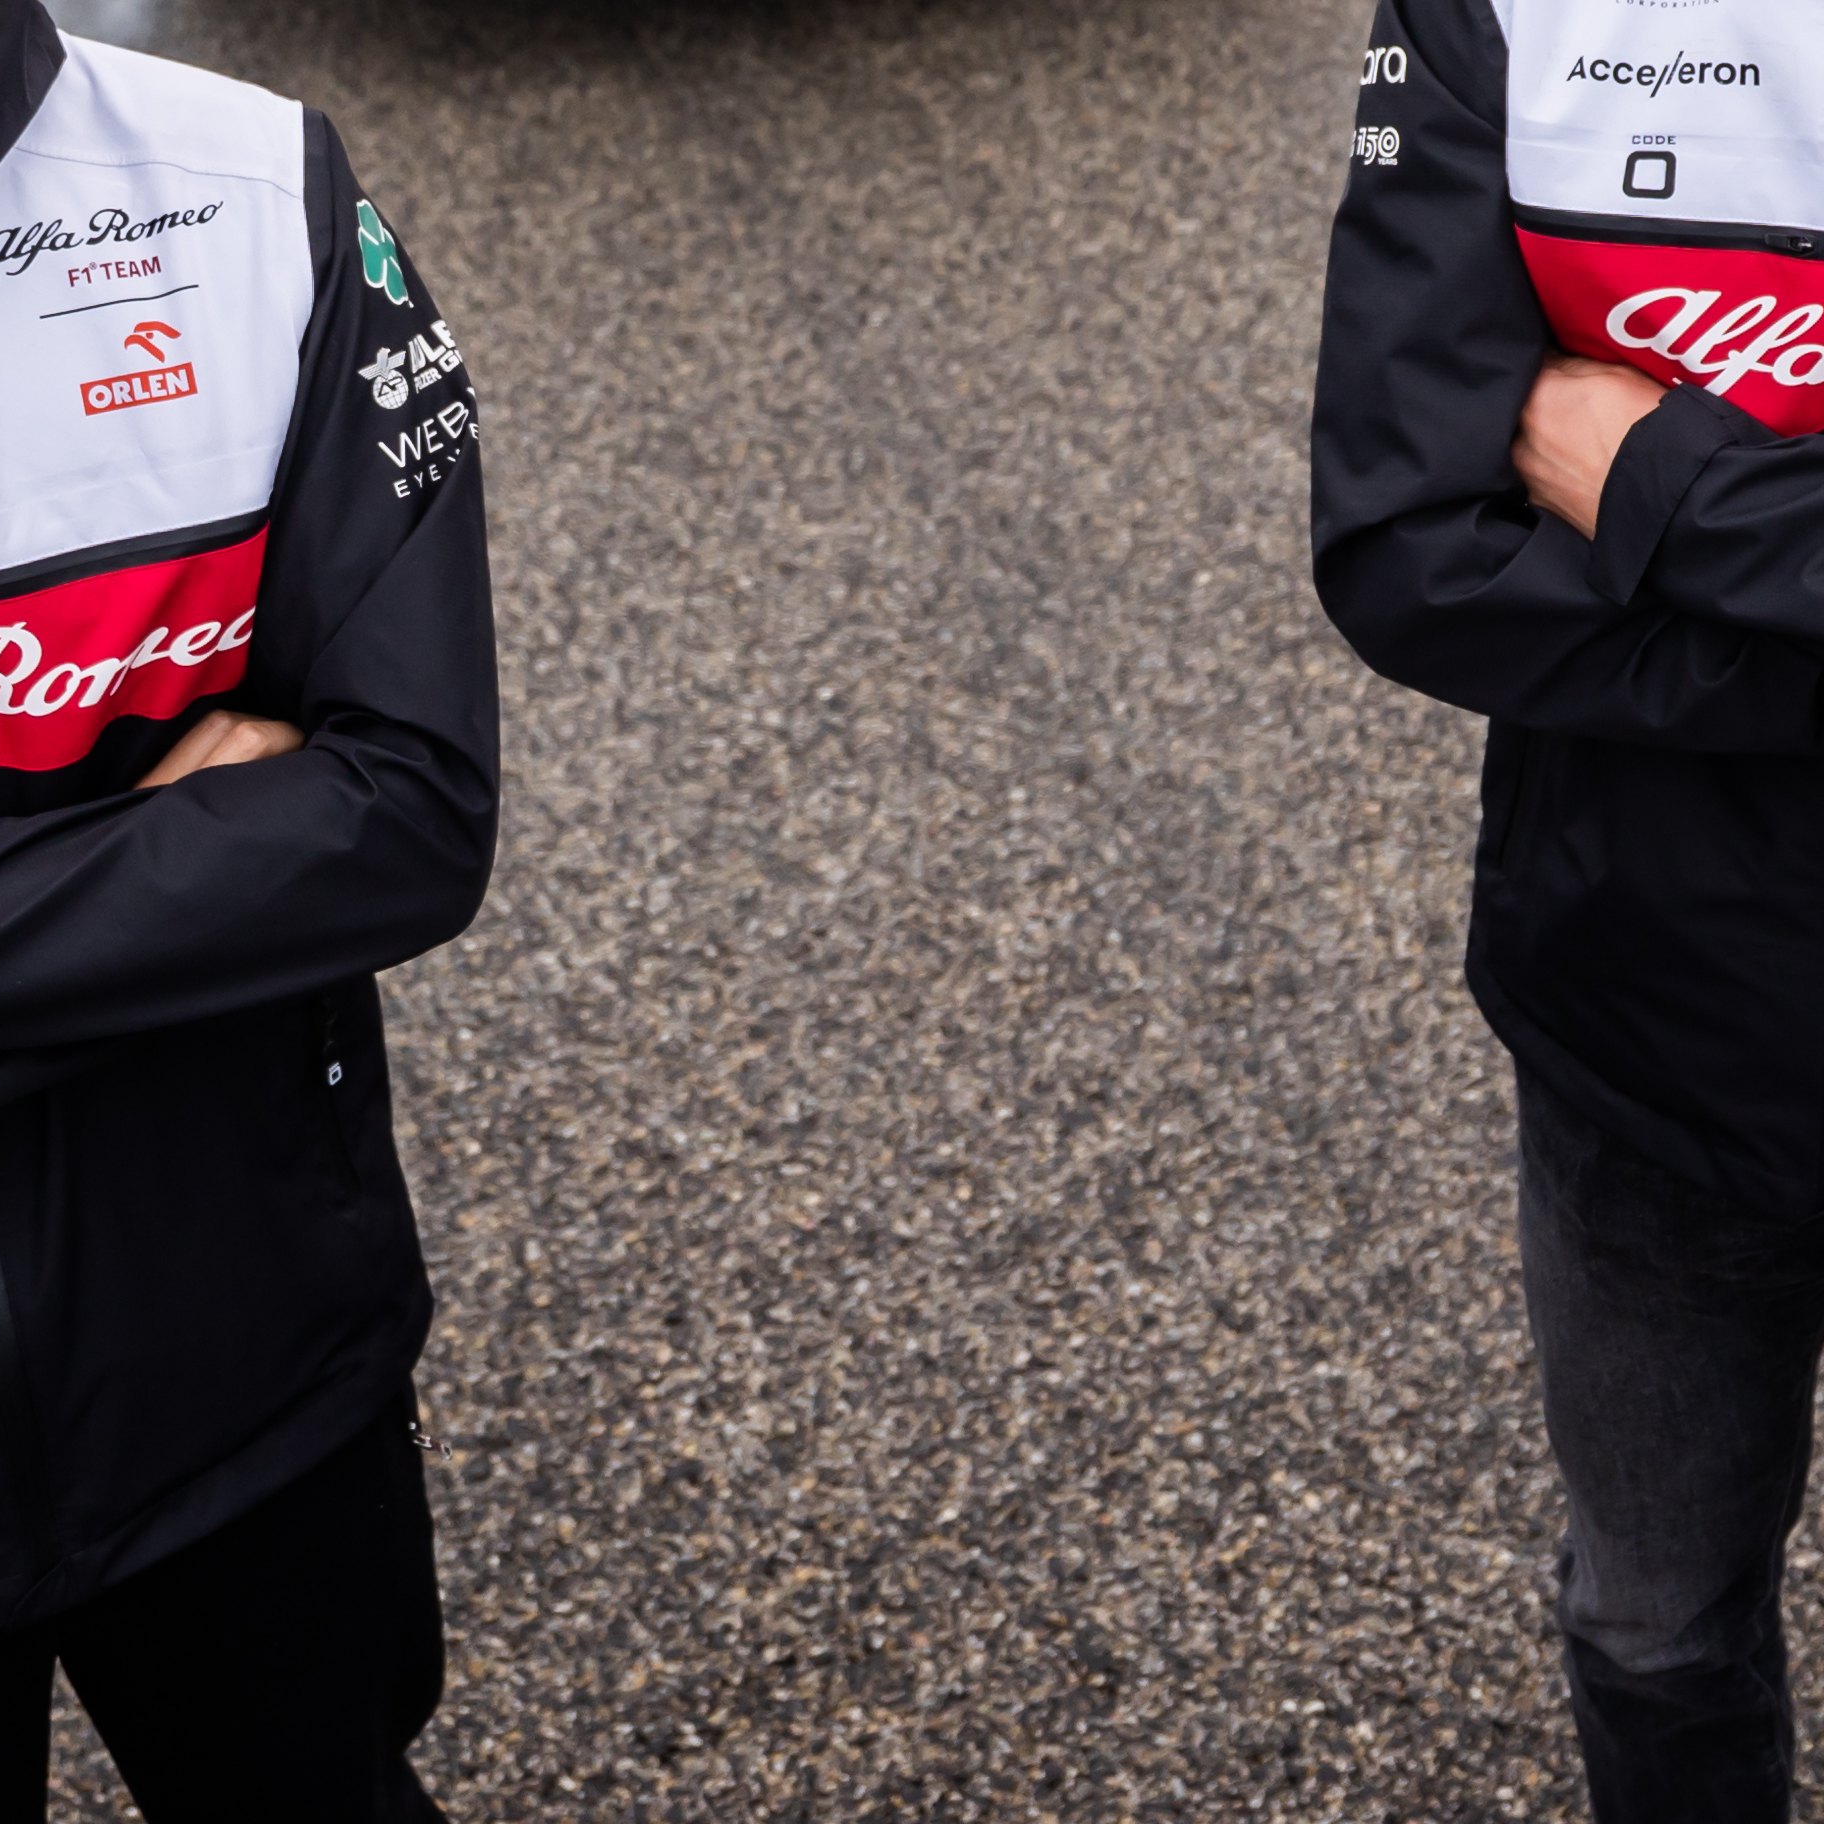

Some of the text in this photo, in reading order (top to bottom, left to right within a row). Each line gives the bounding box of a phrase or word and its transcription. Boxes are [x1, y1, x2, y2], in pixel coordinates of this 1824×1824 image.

[1631, 134, 1677, 146] CODE
[85, 200, 224, 246] Romeo
[100, 255, 163, 281] TEAM
[87, 366, 191, 410] ORLEN
